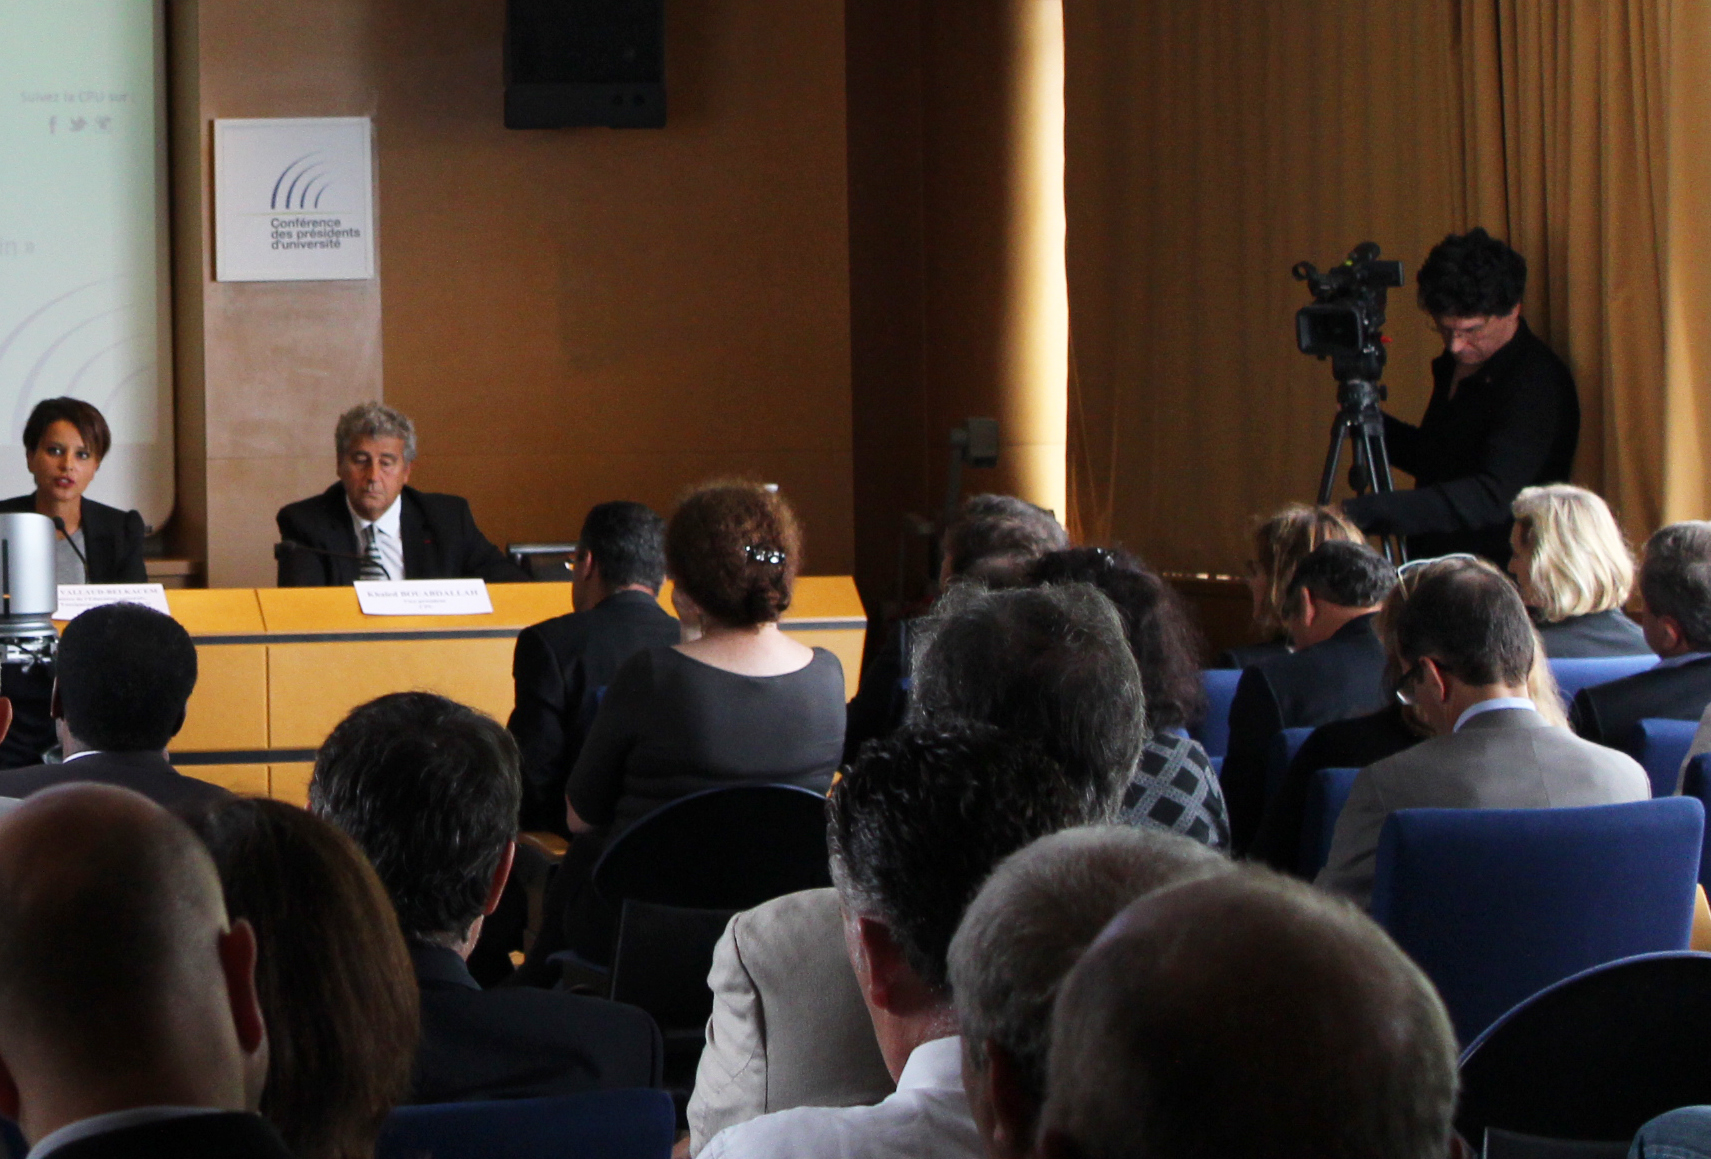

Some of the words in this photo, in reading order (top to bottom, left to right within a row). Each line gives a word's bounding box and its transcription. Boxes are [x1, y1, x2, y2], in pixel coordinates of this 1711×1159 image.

[78, 91, 106, 103] CPU
[271, 218, 341, 229] Conférence
[271, 229, 293, 239] des
[297, 228, 361, 241] présidents
[271, 239, 341, 250] d'université
